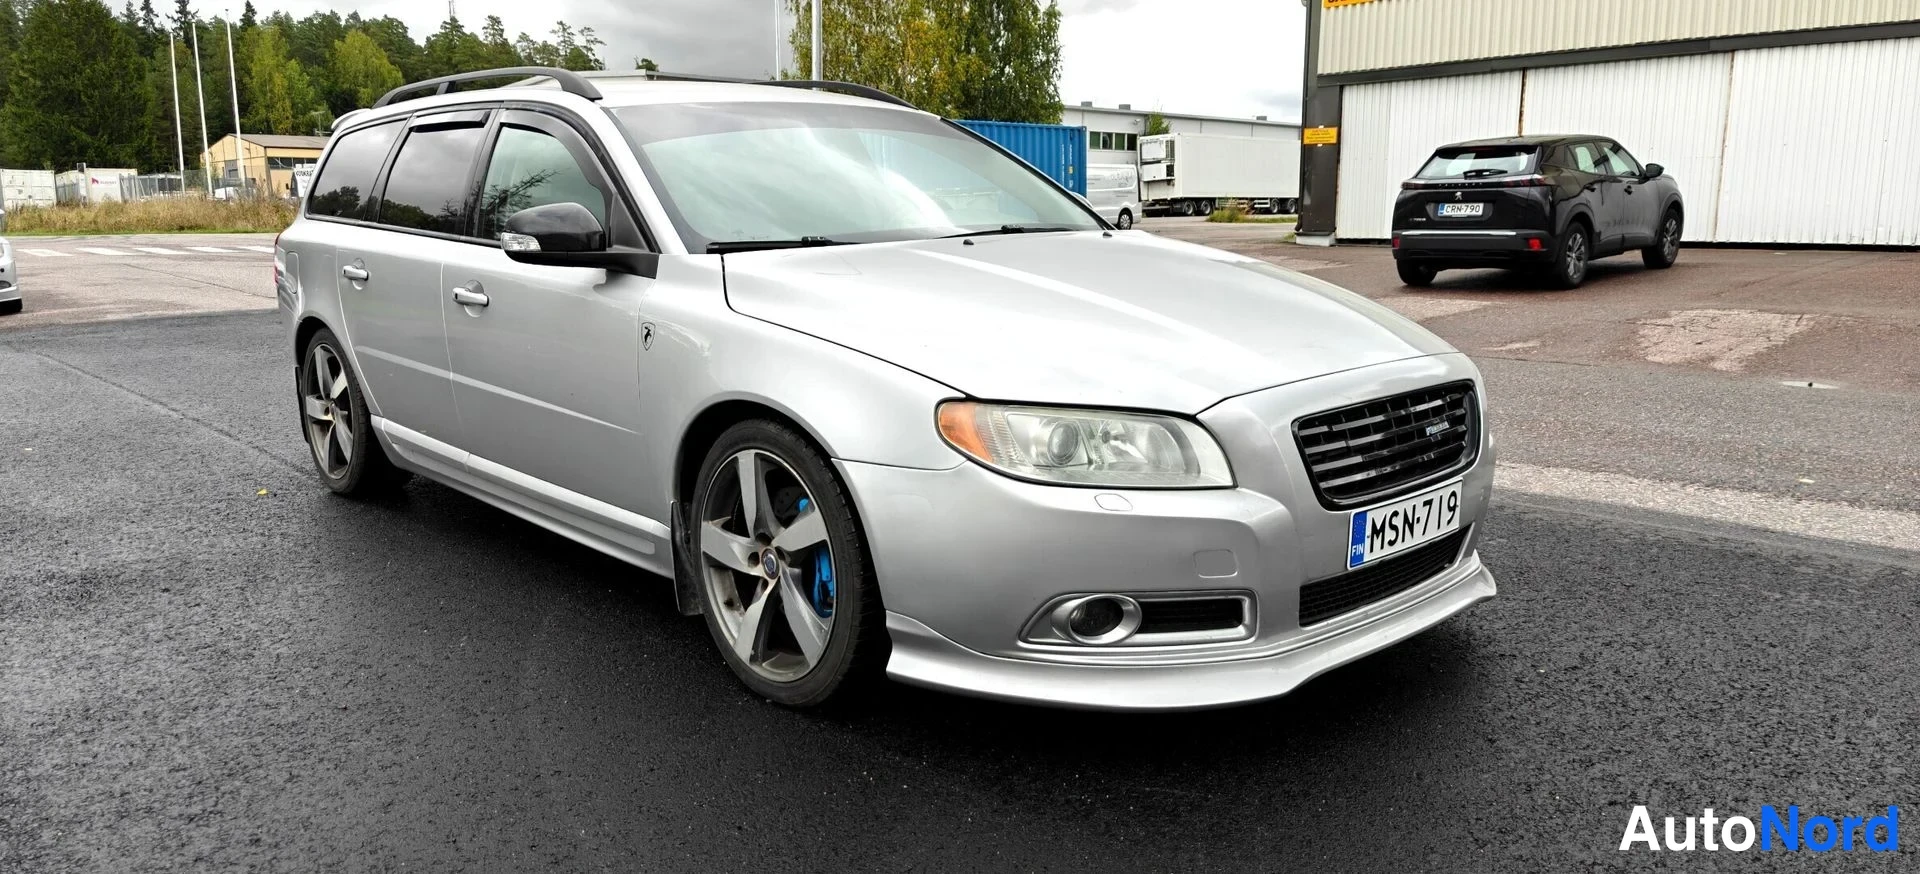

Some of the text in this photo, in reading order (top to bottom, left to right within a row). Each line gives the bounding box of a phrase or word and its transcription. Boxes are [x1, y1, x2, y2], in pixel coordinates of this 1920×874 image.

[1445, 205, 1480, 213] CRN-790
[1369, 490, 1458, 554] MSN-719
[1351, 543, 1364, 557] FIN
